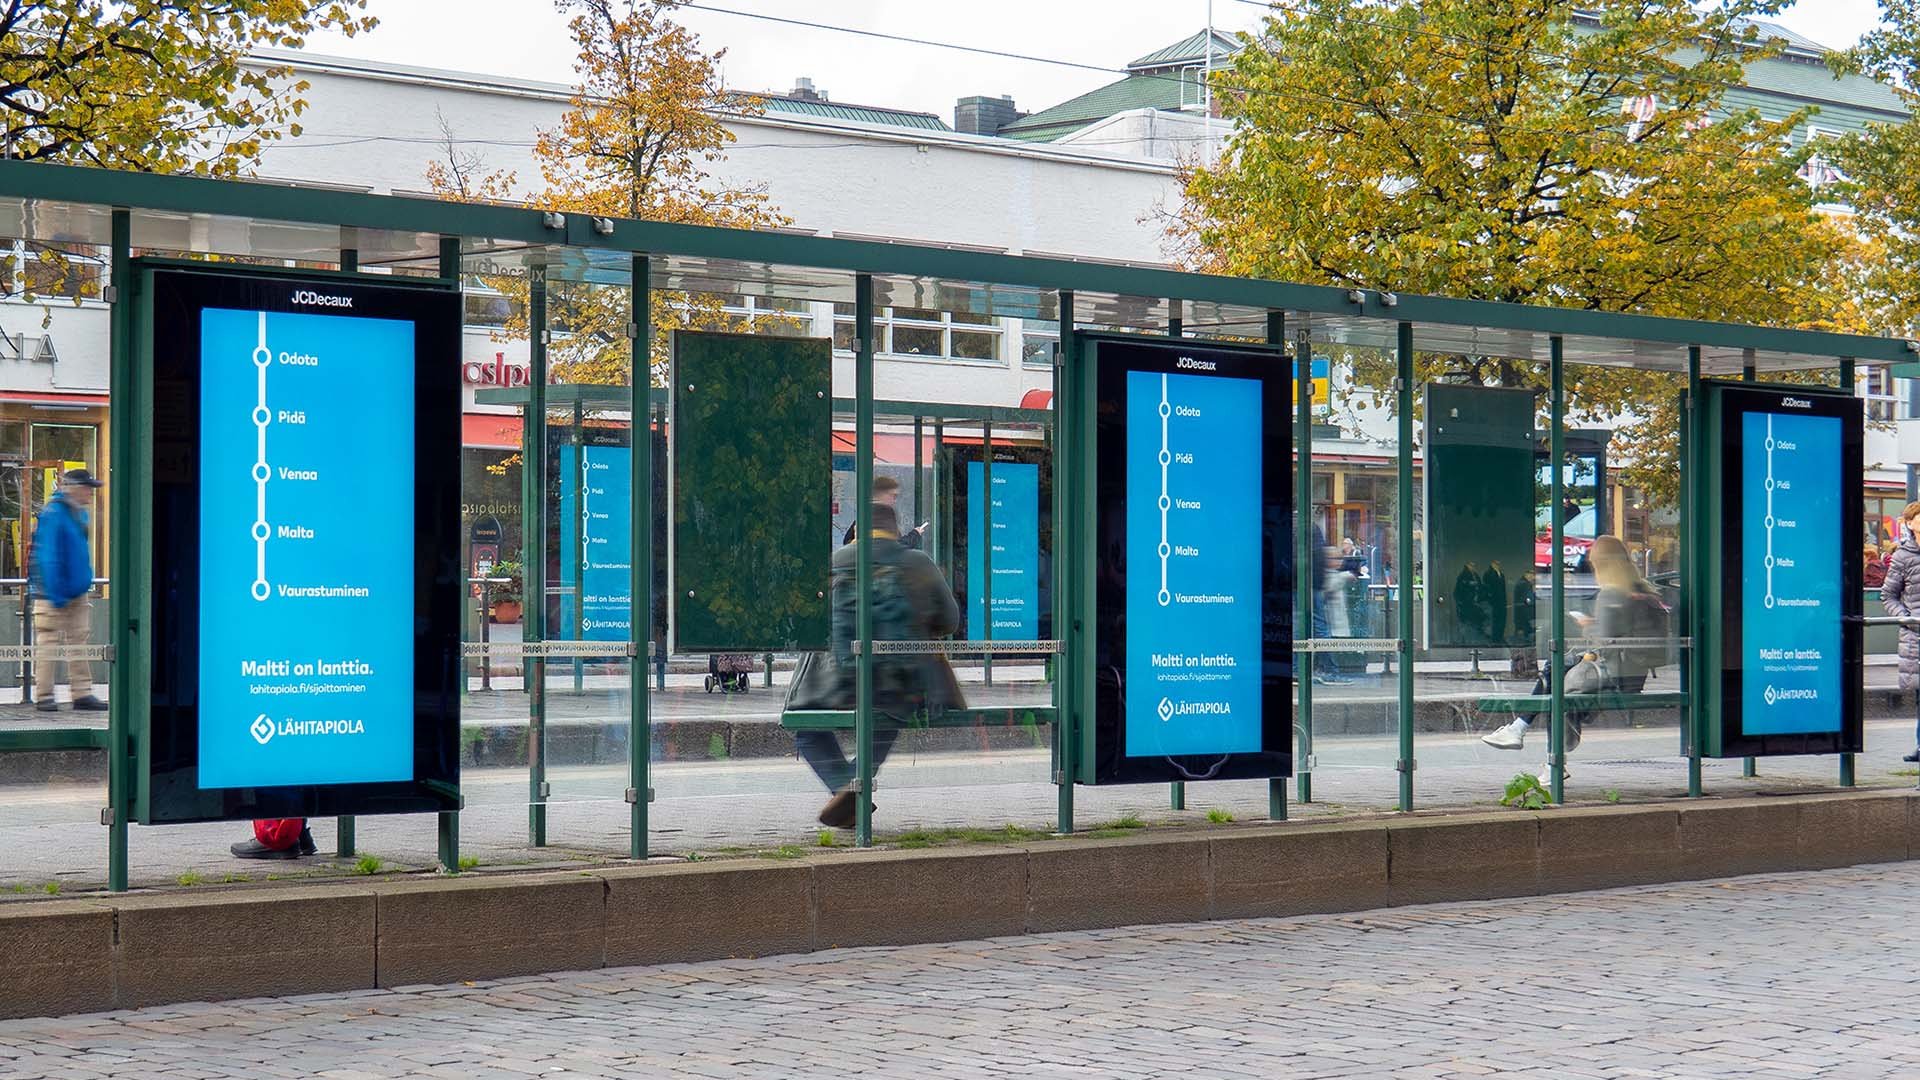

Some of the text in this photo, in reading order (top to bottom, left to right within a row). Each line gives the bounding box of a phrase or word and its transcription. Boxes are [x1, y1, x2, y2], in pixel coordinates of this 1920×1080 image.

[292, 291, 352, 307] JCDecaux
[279, 352, 318, 365] Odota
[1177, 357, 1216, 370] JCDecaux
[1175, 406, 1201, 416] Odota
[279, 411, 305, 424] Pidä
[1776, 440, 1796, 450] Odota
[1175, 454, 1194, 463] Pidä
[279, 467, 317, 480] Venaa
[1175, 499, 1201, 509] Venaa
[278, 526, 314, 538] Malta
[1174, 546, 1199, 556] Malta
[278, 585, 368, 596] Vaurastuminen
[1174, 593, 1234, 603] Vaurastuminen
[1152, 654, 1236, 667] Maltti on lanttia.
[1760, 649, 1783, 659] Maltti
[1784, 650, 1794, 660] on
[242, 659, 373, 676] Maltti on lanttia.
[250, 683, 365, 695] lahitapiola.fi/sijoittaminen
[1775, 689, 1818, 699] LÄHITAPIOLA
[1176, 701, 1230, 714] LÄHITAPIOLA
[278, 719, 364, 735] LÄHITAPIOLA
